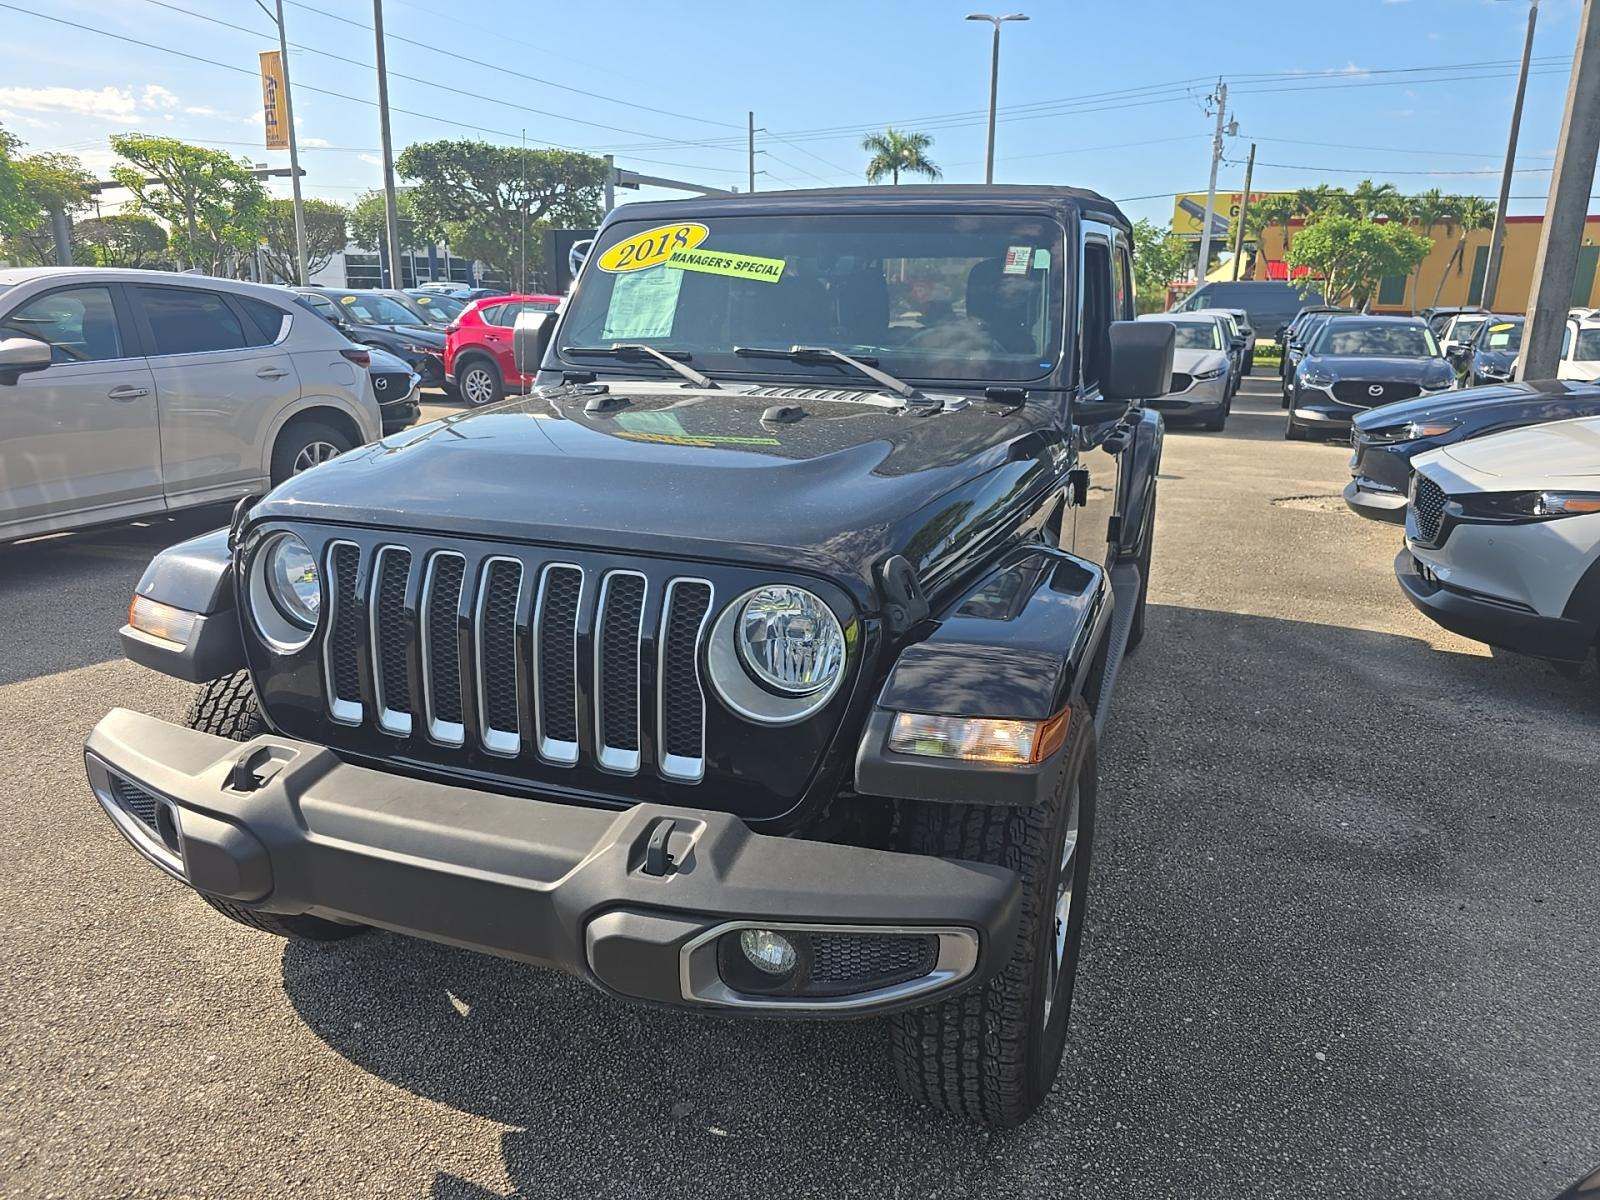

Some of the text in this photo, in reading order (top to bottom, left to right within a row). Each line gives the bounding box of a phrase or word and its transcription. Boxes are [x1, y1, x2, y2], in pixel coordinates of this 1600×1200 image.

[615, 227, 691, 269] 2018
[669, 252, 779, 276] MANAGER'S SPECIAL
